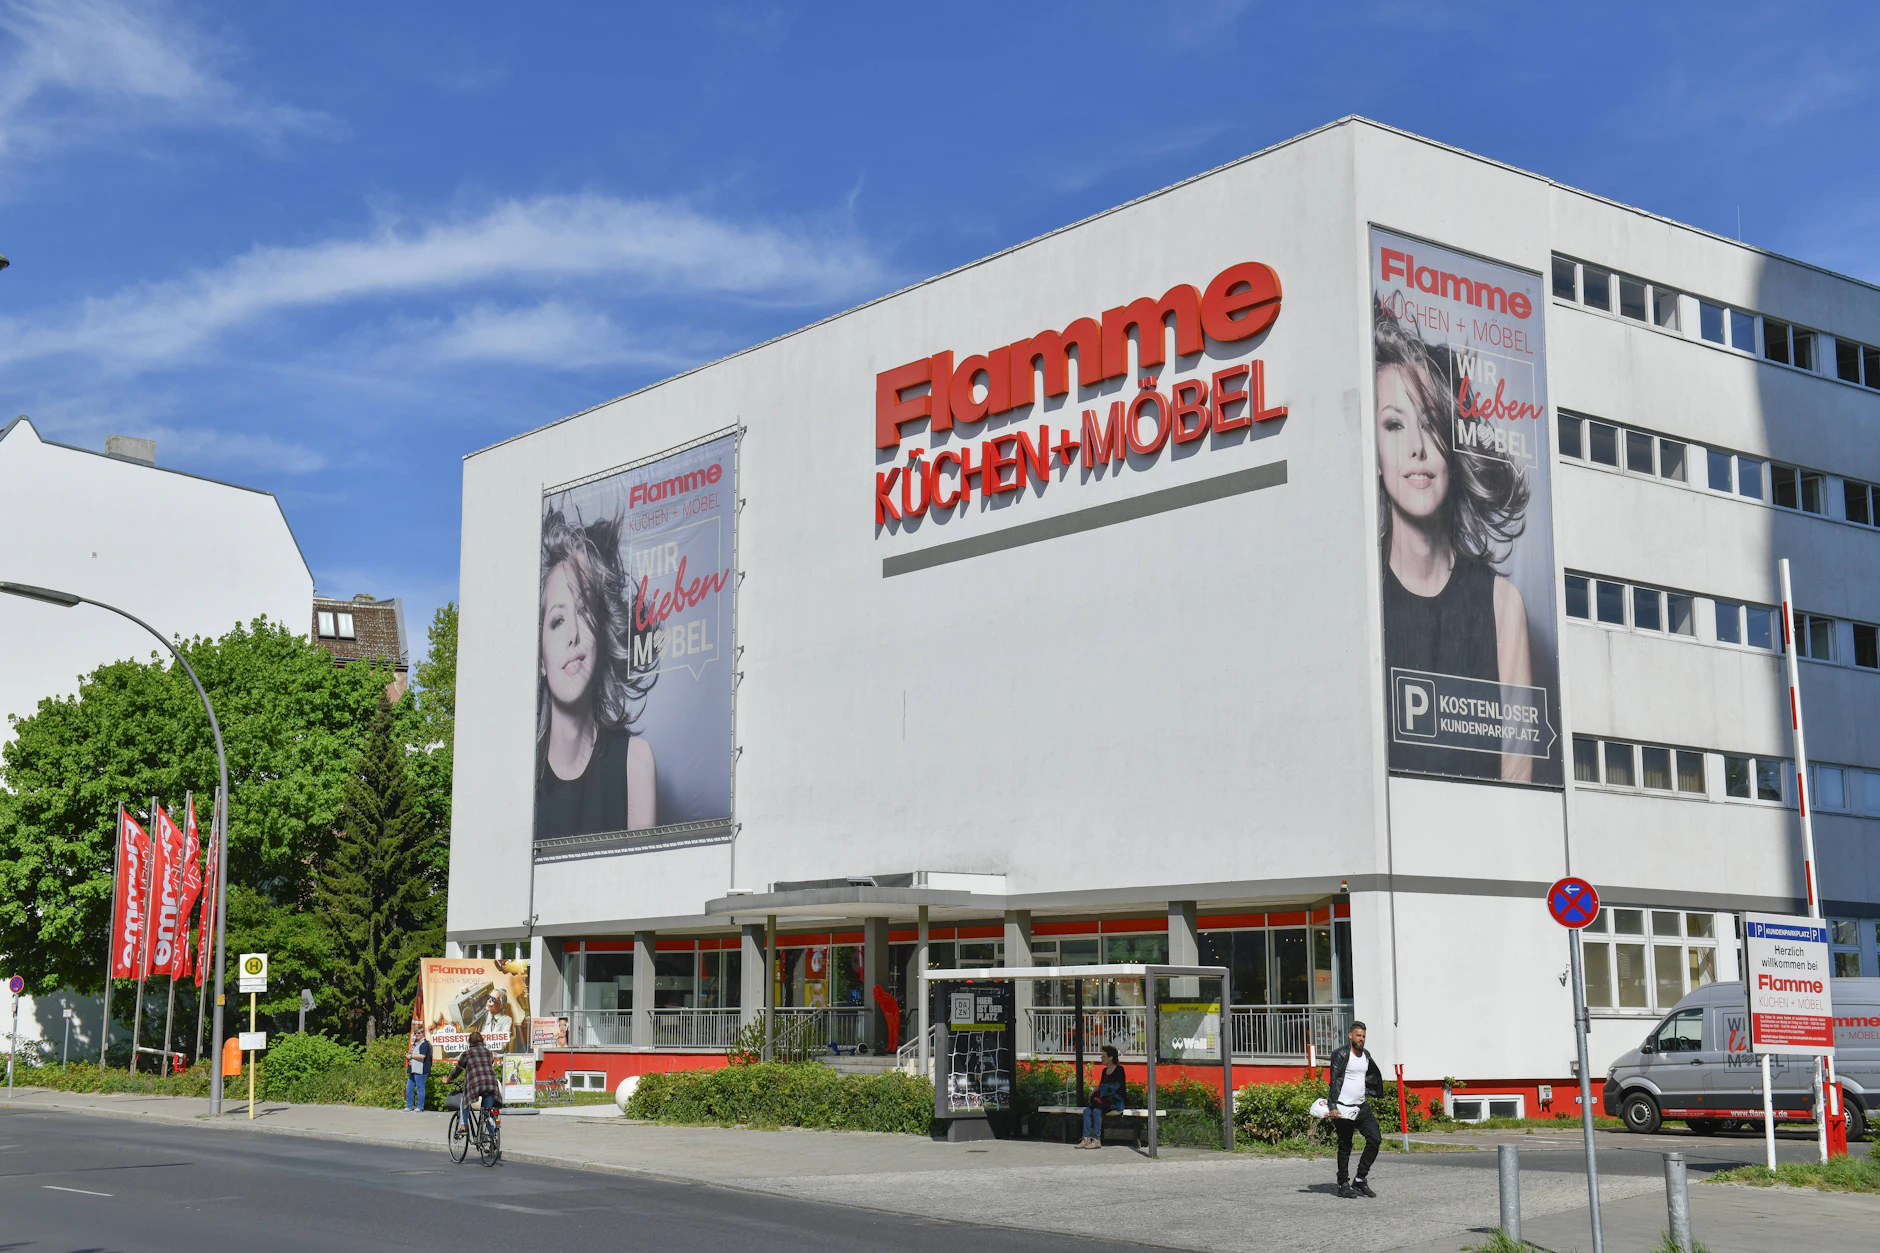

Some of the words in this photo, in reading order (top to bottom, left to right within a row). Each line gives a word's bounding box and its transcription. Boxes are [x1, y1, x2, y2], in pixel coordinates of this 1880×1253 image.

[1473, 319, 1534, 355] MÖBEL
[876, 261, 1282, 449] Flamme
[1456, 352, 1497, 387] WIR
[1459, 375, 1543, 422] lieben
[629, 507, 669, 534] KÜCHEN
[682, 492, 721, 518] MÖBEL
[636, 541, 679, 581] WIR
[635, 556, 729, 632] lieben
[1404, 684, 1429, 730] P
[1440, 695, 1539, 724] KOSTENLOSER
[1440, 718, 1540, 742] KUNDENPARKPLATZ
[1765, 928, 1810, 938] KUNDENPARKPLATZ
[1774, 945, 1804, 956] Herzlich
[429, 964, 485, 975] Flamme
[1761, 957, 1806, 970] willkommen
[1807, 960, 1818, 970] bei
[1758, 974, 1823, 993] Flamme
[976, 996, 993, 1005] HIER
[1759, 994, 1789, 1009] KÜCHEN
[1797, 996, 1824, 1010] MÖBEL
[976, 1005, 988, 1013] IST
[989, 1005, 1003, 1013] DER
[976, 1013, 998, 1021] PLATZ
[1727, 1017, 1746, 1031] WI
[432, 1035, 469, 1043] HEISSEST
[1183, 1037, 1208, 1050] Wall
[1730, 1109, 1788, 1118] www.flame.de
